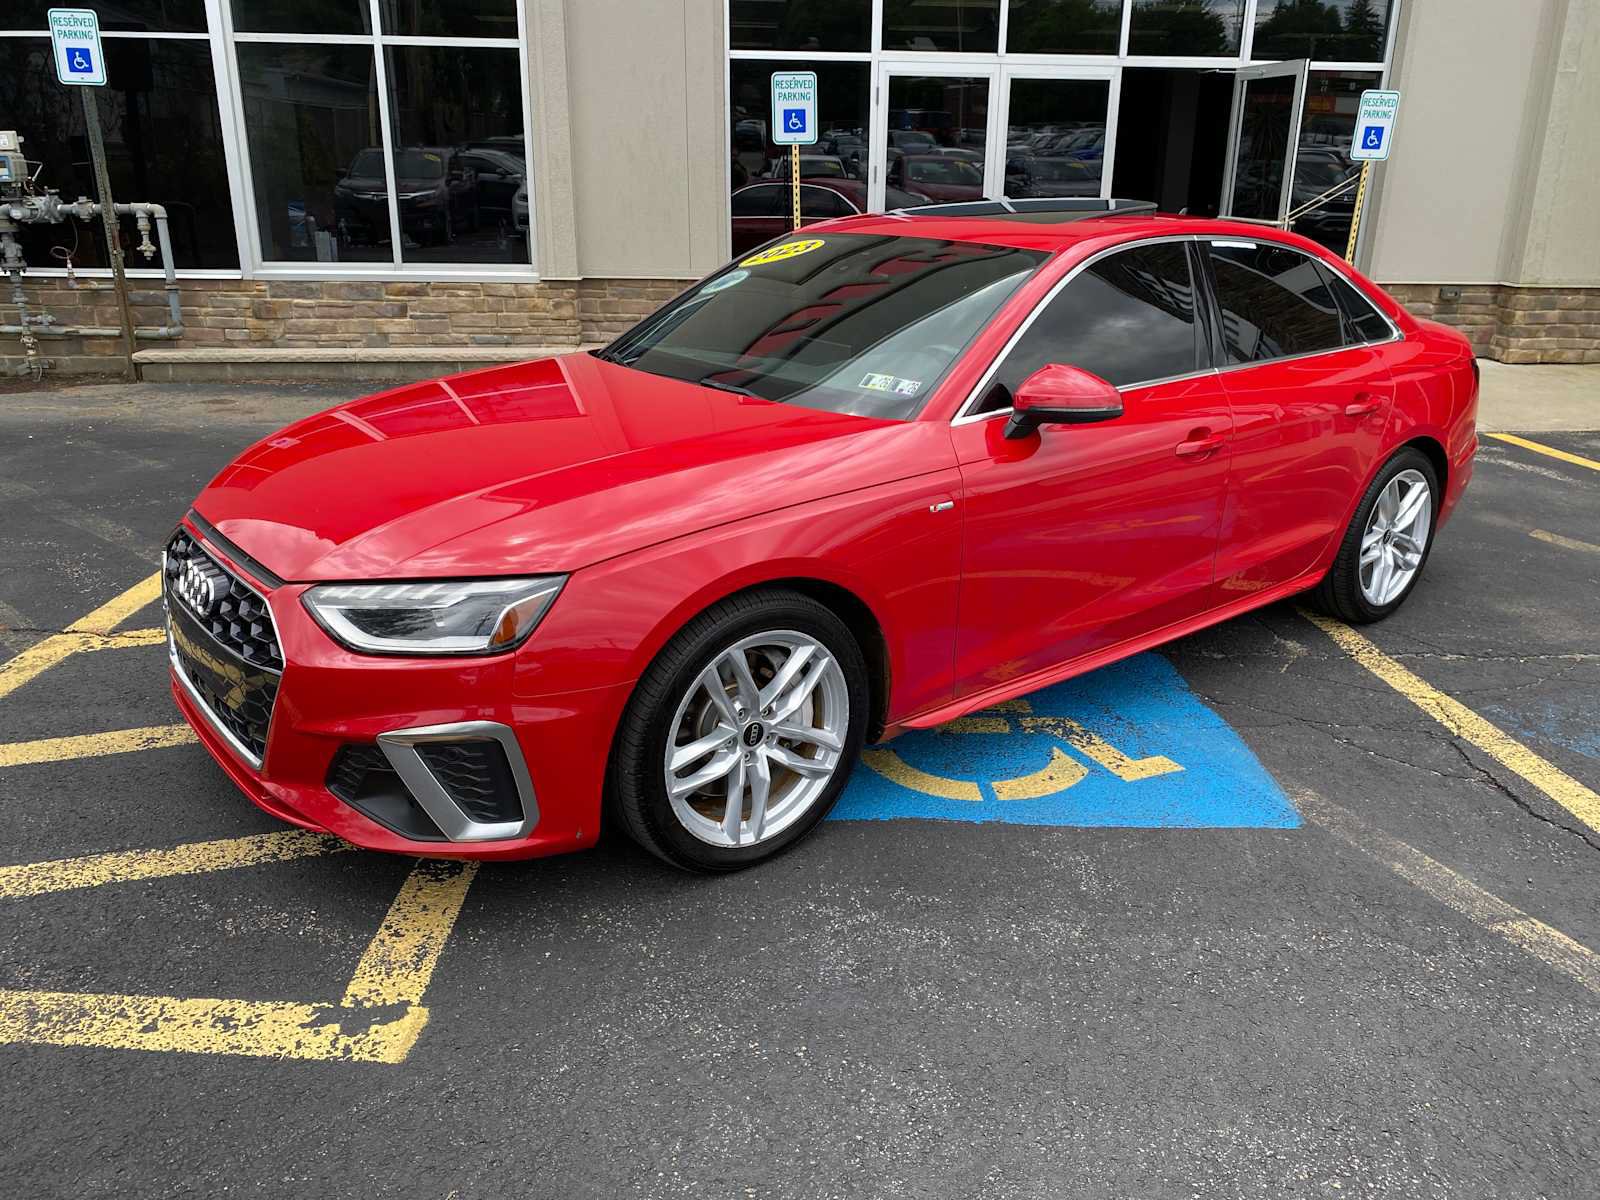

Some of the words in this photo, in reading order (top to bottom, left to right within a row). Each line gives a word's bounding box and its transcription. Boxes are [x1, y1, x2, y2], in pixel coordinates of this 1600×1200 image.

[52, 16, 94, 27] RESERVED
[57, 29, 94, 40] PARKING
[775, 79, 813, 89] RESERVED
[778, 92, 811, 101] PARKING
[1362, 97, 1397, 108] RESERVED
[1363, 109, 1393, 119] PARKING
